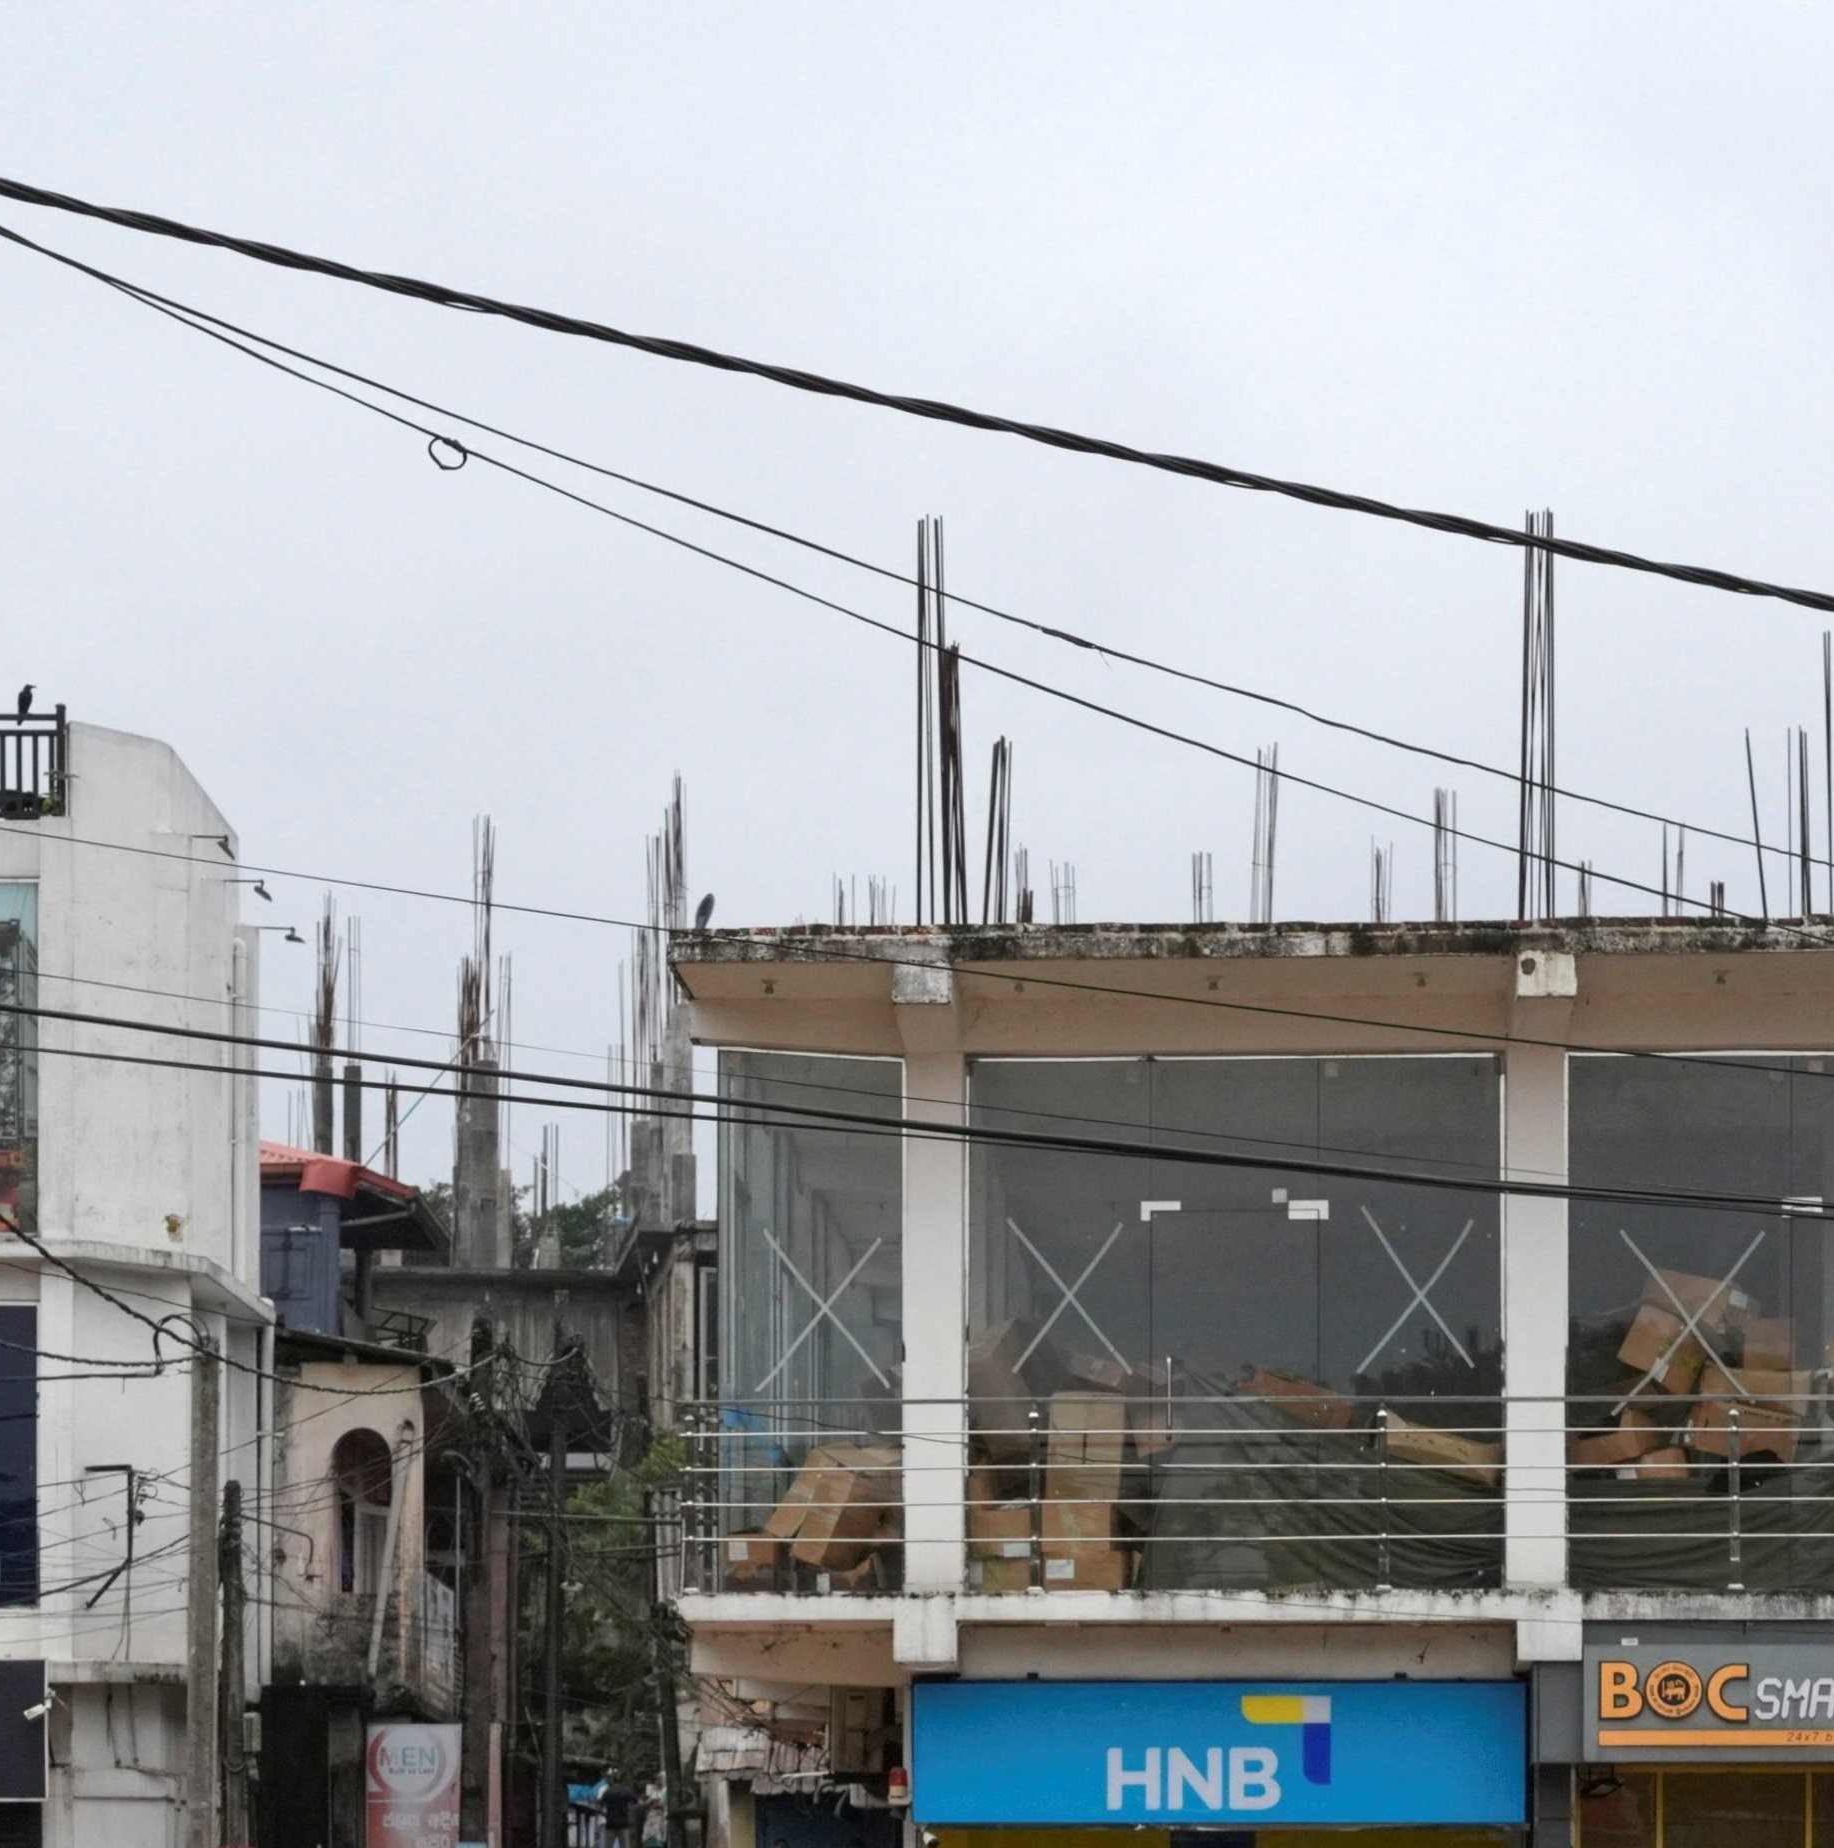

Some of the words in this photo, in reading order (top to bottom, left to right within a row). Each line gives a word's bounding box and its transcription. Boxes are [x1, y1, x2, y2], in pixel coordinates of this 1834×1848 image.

[1599, 1660, 1750, 1722] BOC
[1786, 1731, 1820, 1742] 24x7
[1107, 1747, 1281, 1810] HNB
